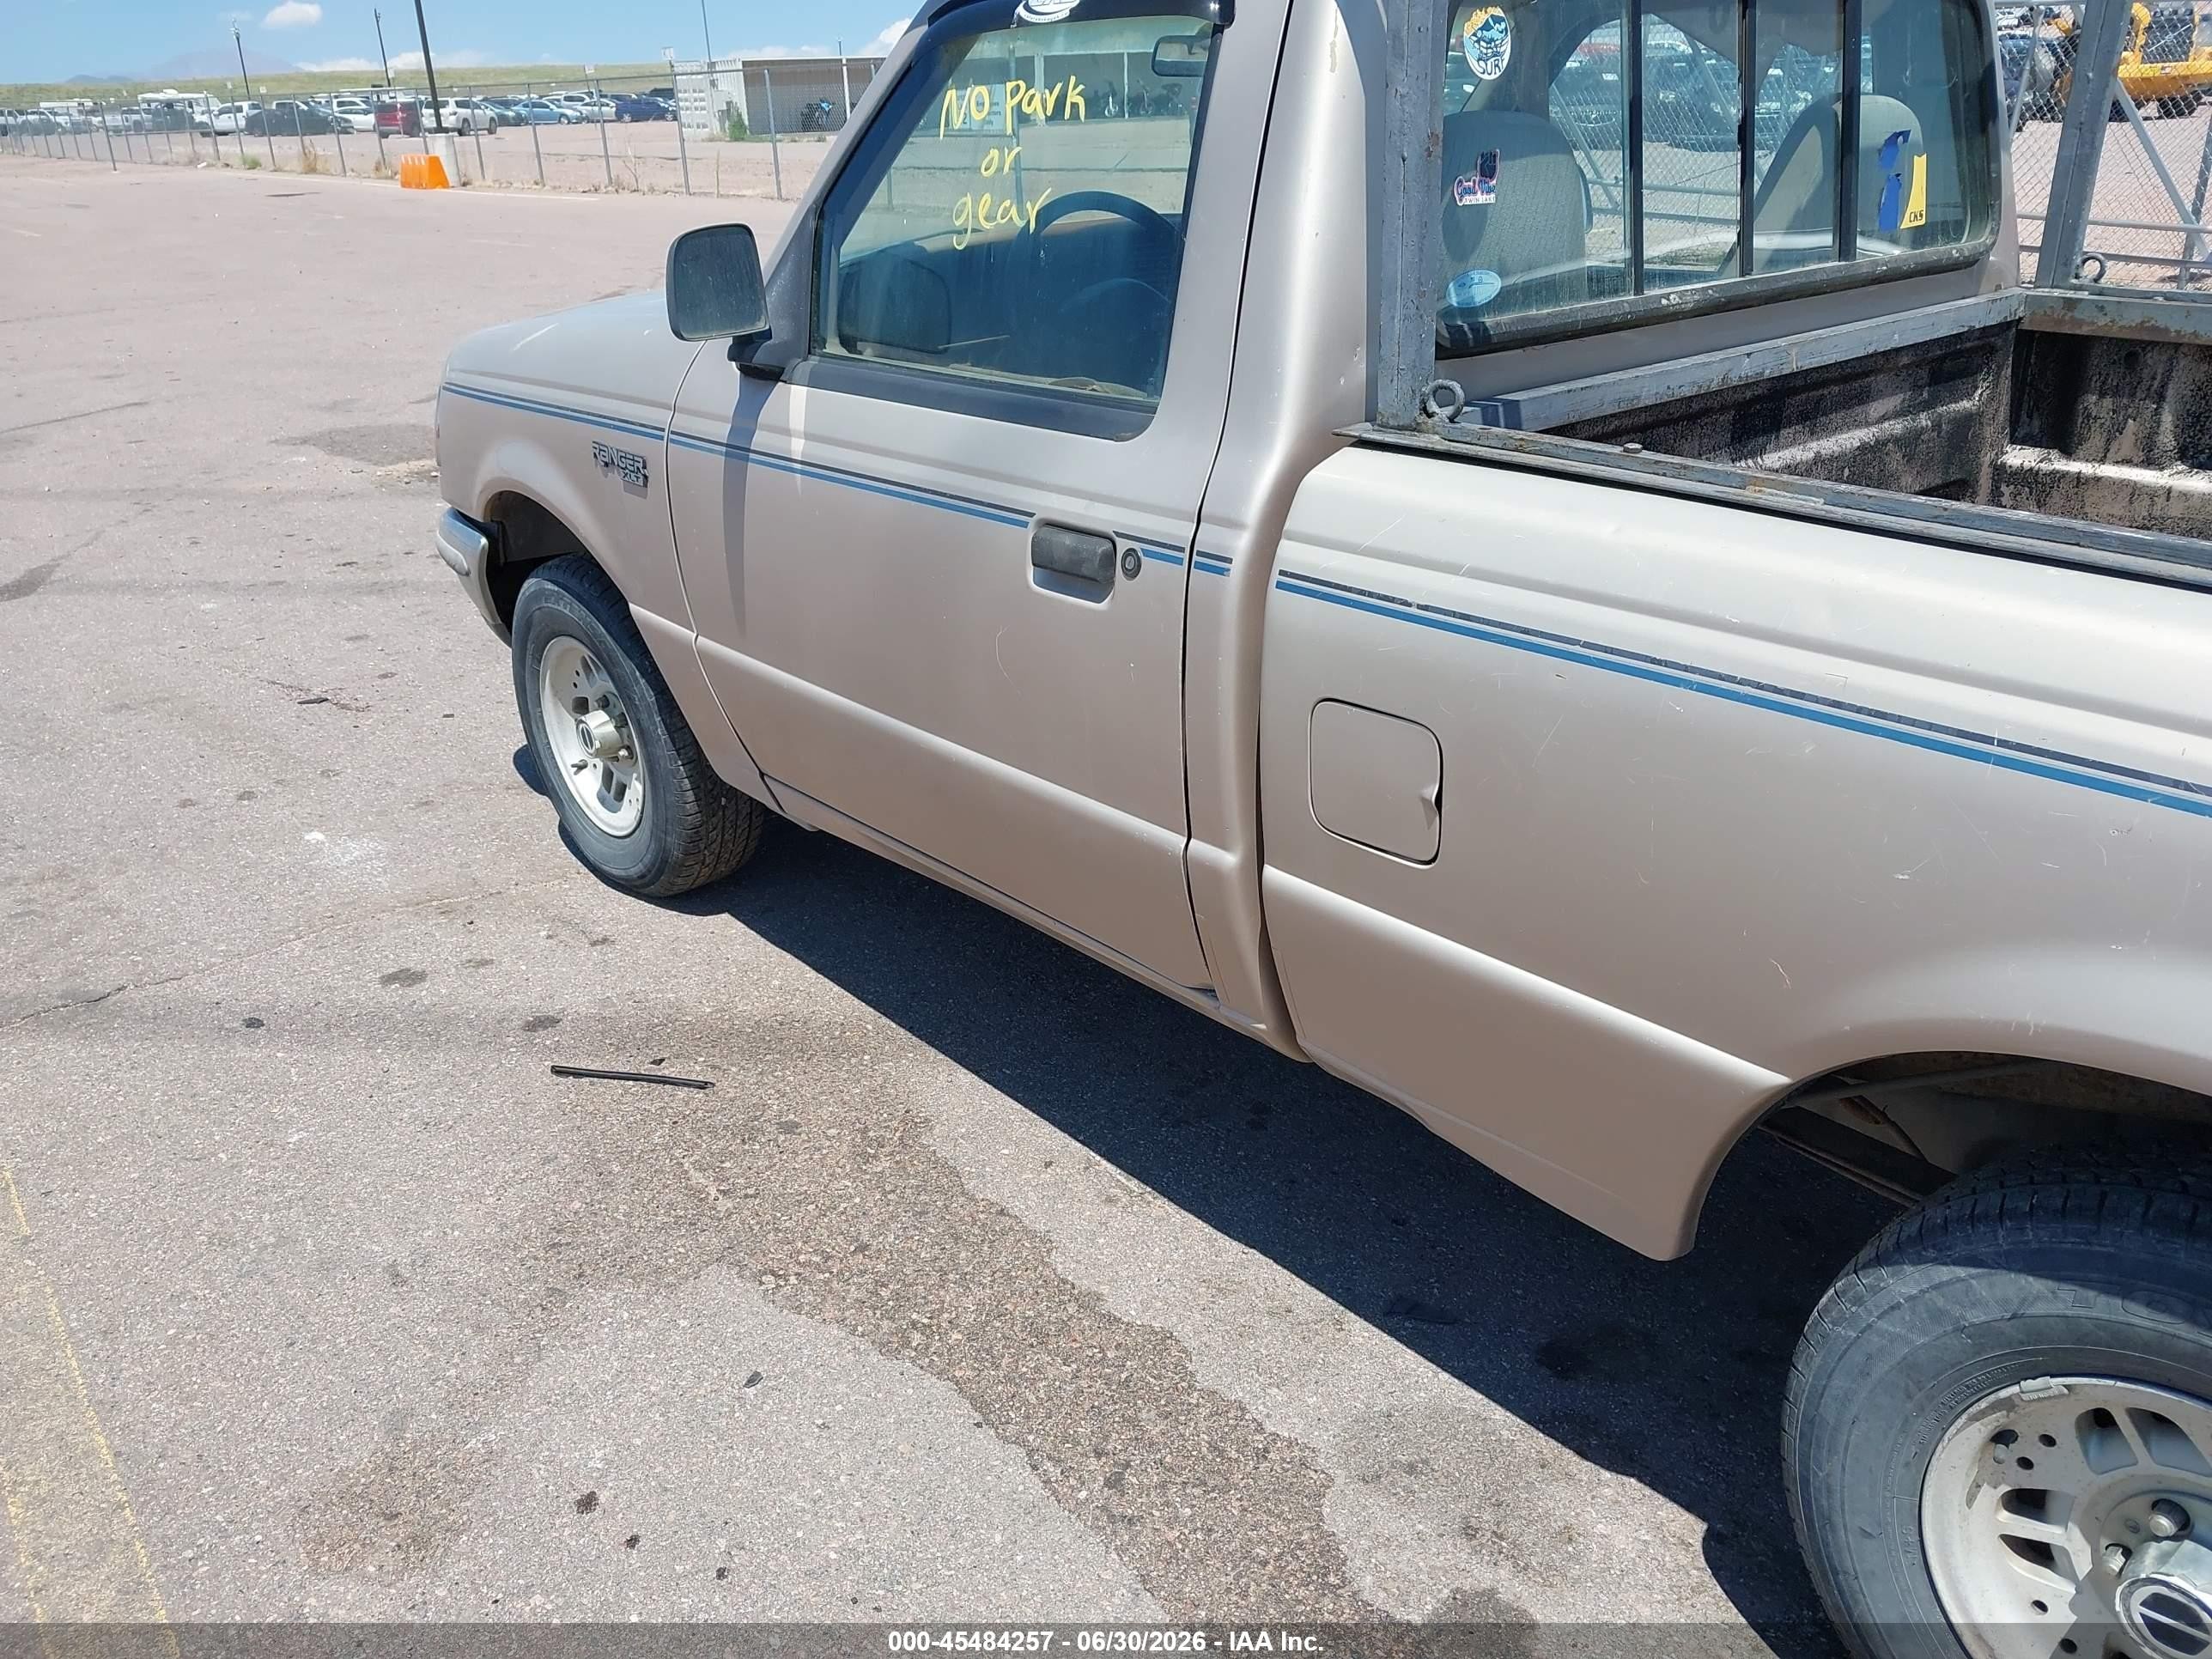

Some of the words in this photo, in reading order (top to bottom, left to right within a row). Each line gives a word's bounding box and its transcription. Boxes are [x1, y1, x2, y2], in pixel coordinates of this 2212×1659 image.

[1477, 57, 1505, 76] SURF
[981, 146, 1023, 177] or
[1456, 178, 1477, 198] Good
[952, 187, 1052, 250] gear
[622, 470, 644, 485] XLT
